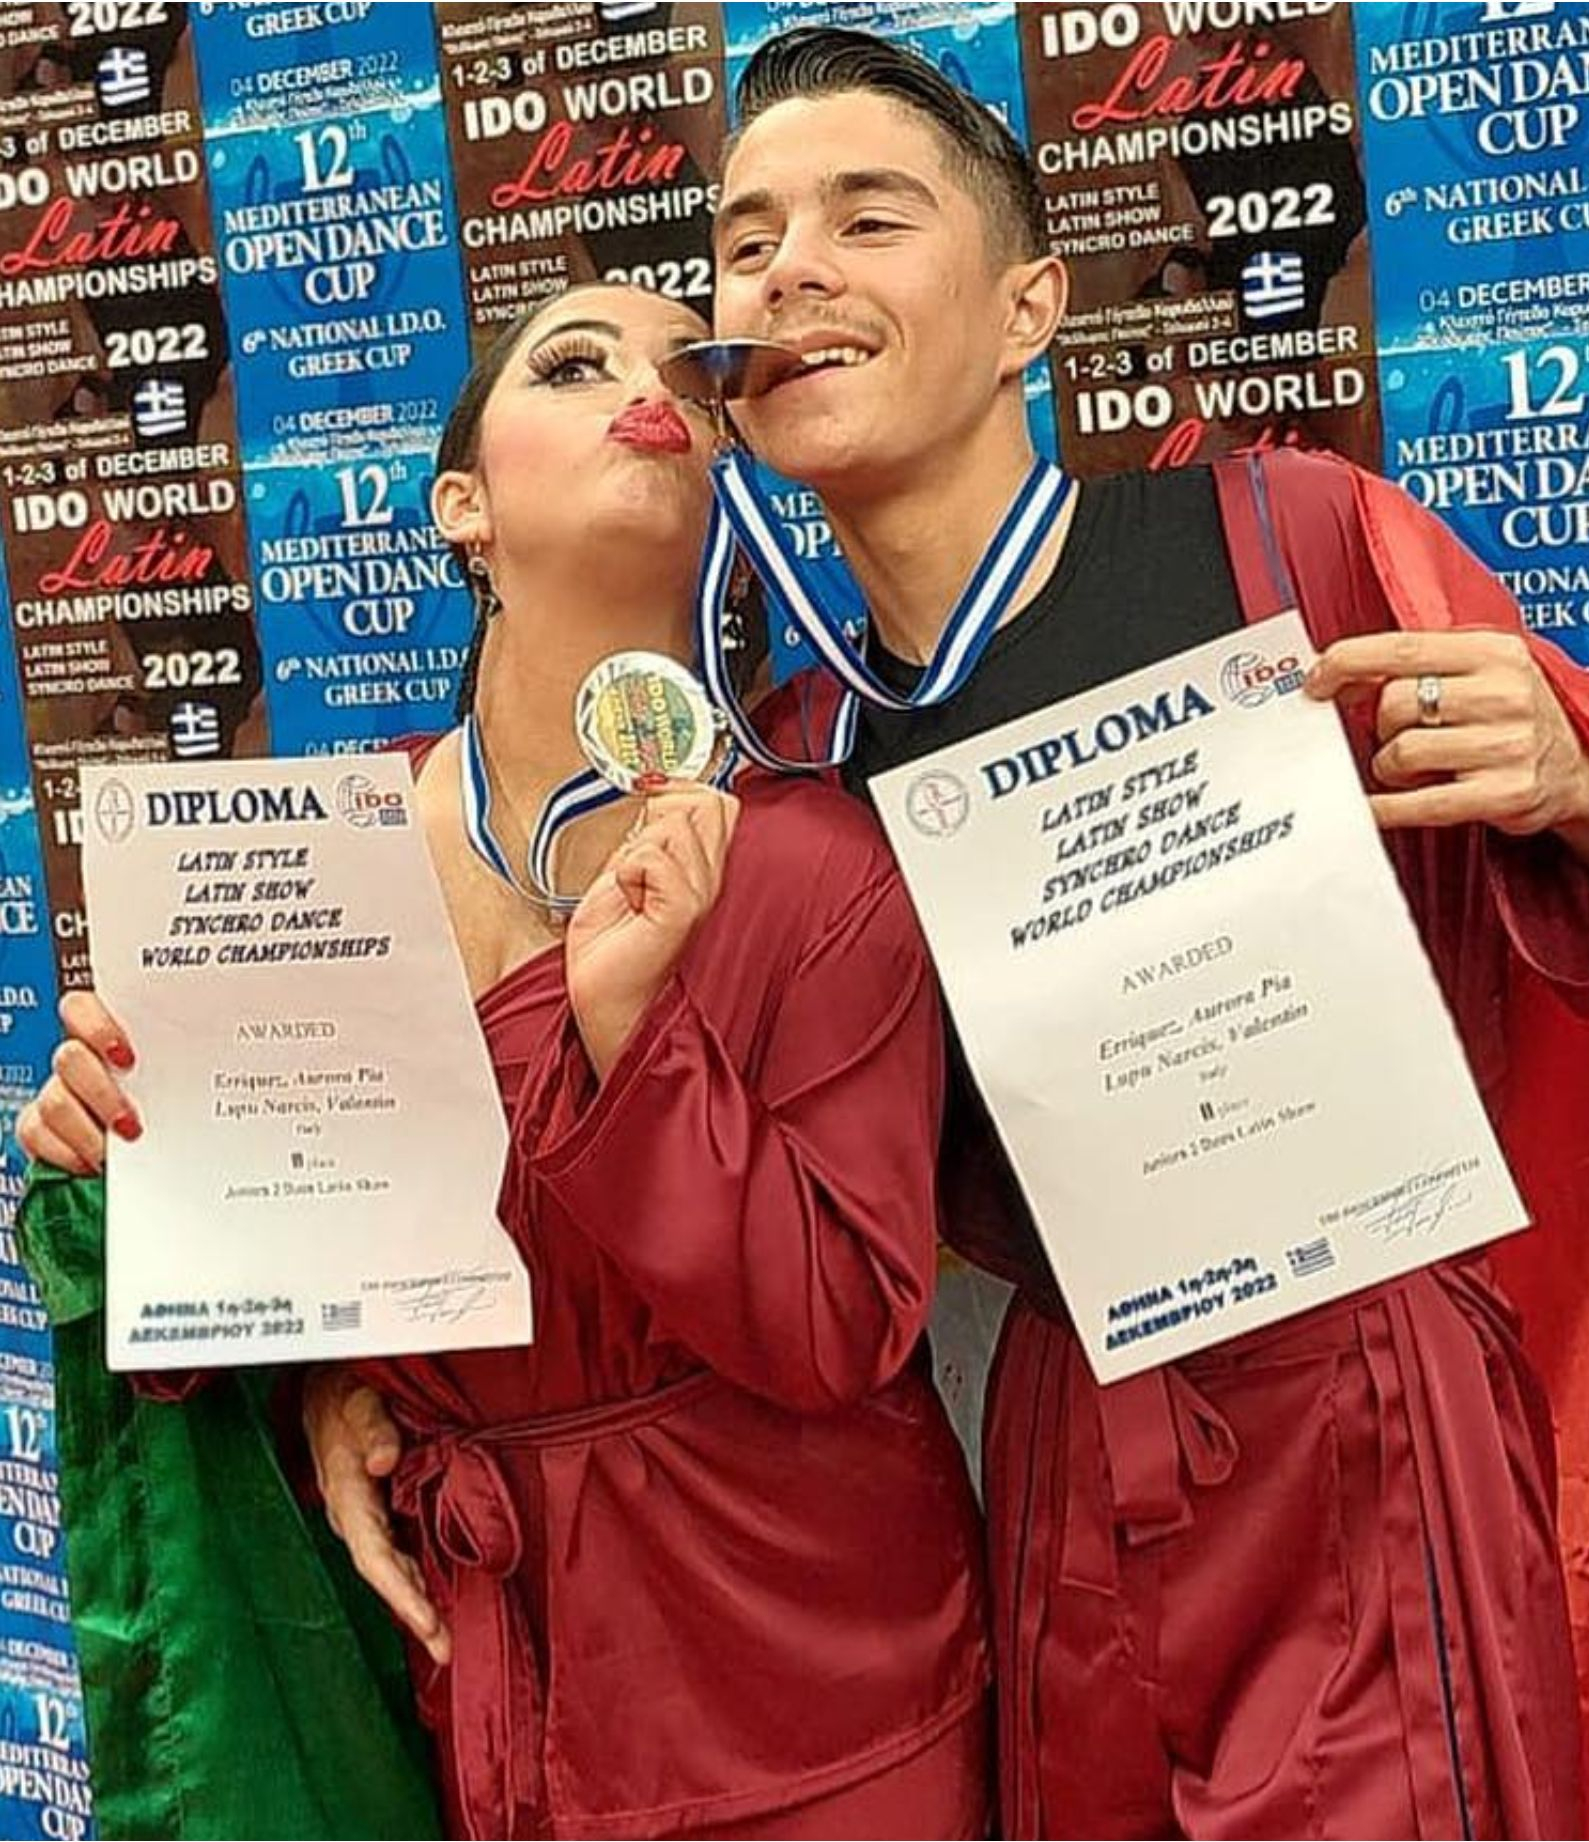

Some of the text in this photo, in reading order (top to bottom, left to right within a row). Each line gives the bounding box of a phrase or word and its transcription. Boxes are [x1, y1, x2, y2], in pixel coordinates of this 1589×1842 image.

[246, 2, 372, 38] GREEK CUP
[1041, 5, 1140, 57] IDO
[256, 51, 399, 93] DECEMBER 2022
[452, 56, 512, 89] 1-2-3
[521, 50, 547, 76] of
[555, 25, 708, 71] DECEMBER
[463, 90, 547, 141] IDO
[563, 67, 715, 122] WORLD
[1072, 35, 1307, 131] Latin
[1368, 66, 1502, 121] OPEN
[26, 111, 192, 156] of DECEMBER
[1037, 102, 1353, 176] CHAMPIONSHIPS
[1477, 103, 1580, 156] CUP
[66, 149, 199, 198] WORLD
[294, 122, 366, 192] 12th
[492, 120, 685, 208] Latin
[223, 179, 442, 232] MEDITERRANEAN
[1045, 183, 1160, 213] LATIN STYLE
[1205, 182, 1336, 239] 2022
[1384, 165, 1588, 217] 6th NATIONAL
[2, 199, 179, 275] Latin
[462, 184, 722, 248] CHAMPIONSHIPS
[1046, 205, 1162, 235] LATIN SHOW
[1446, 207, 1554, 245] GREEK
[225, 210, 449, 274] OPEN DANCE
[1049, 222, 1195, 257] SYNCRO DANCE
[304, 262, 377, 304] CUP
[470, 254, 569, 283] LATIN STYLE
[472, 278, 570, 304] LATIN SHOW
[1419, 289, 1450, 313] 04
[105, 325, 208, 367] 2022
[269, 317, 382, 349] NATIONAL
[1064, 327, 1358, 380] 1-2-3 of DECEMBER
[287, 344, 411, 379] GREEK CUP
[300, 404, 395, 432] DECEMBER
[1076, 367, 1366, 434] IDO WORLD
[4, 444, 230, 486] 1-2-3 of DECEMBER
[13, 479, 236, 532] IDO WORLD
[335, 464, 407, 528] 12th
[40, 520, 214, 593] Latin
[15, 584, 252, 628] CHAMPIONSHIPS
[261, 566, 362, 603] OPEN
[343, 599, 415, 638] CUP
[142, 649, 241, 688] 2022
[305, 649, 419, 678] NATIONAL
[1244, 656, 1300, 688] IDO
[323, 677, 451, 707] GREEK CUP
[980, 683, 1216, 798] DIPLOMA
[147, 787, 328, 827] DIPLOMA
[1042, 751, 1199, 832] LATIN STYLE
[1056, 782, 1207, 863] LATIN SHOW
[177, 847, 309, 874] LATIN STYLE
[1043, 802, 1242, 903] SYNCHRO DANCE
[184, 878, 315, 904] LATIN SHOW
[1010, 812, 1296, 949] WORLD CHAMPIONSHIPS
[168, 907, 343, 937] SYNCHRO DANCE
[141, 936, 391, 968] WORLD CHAMPIONSHIPS
[1121, 935, 1234, 995] AWARDED
[236, 1022, 337, 1042] AWARDED
